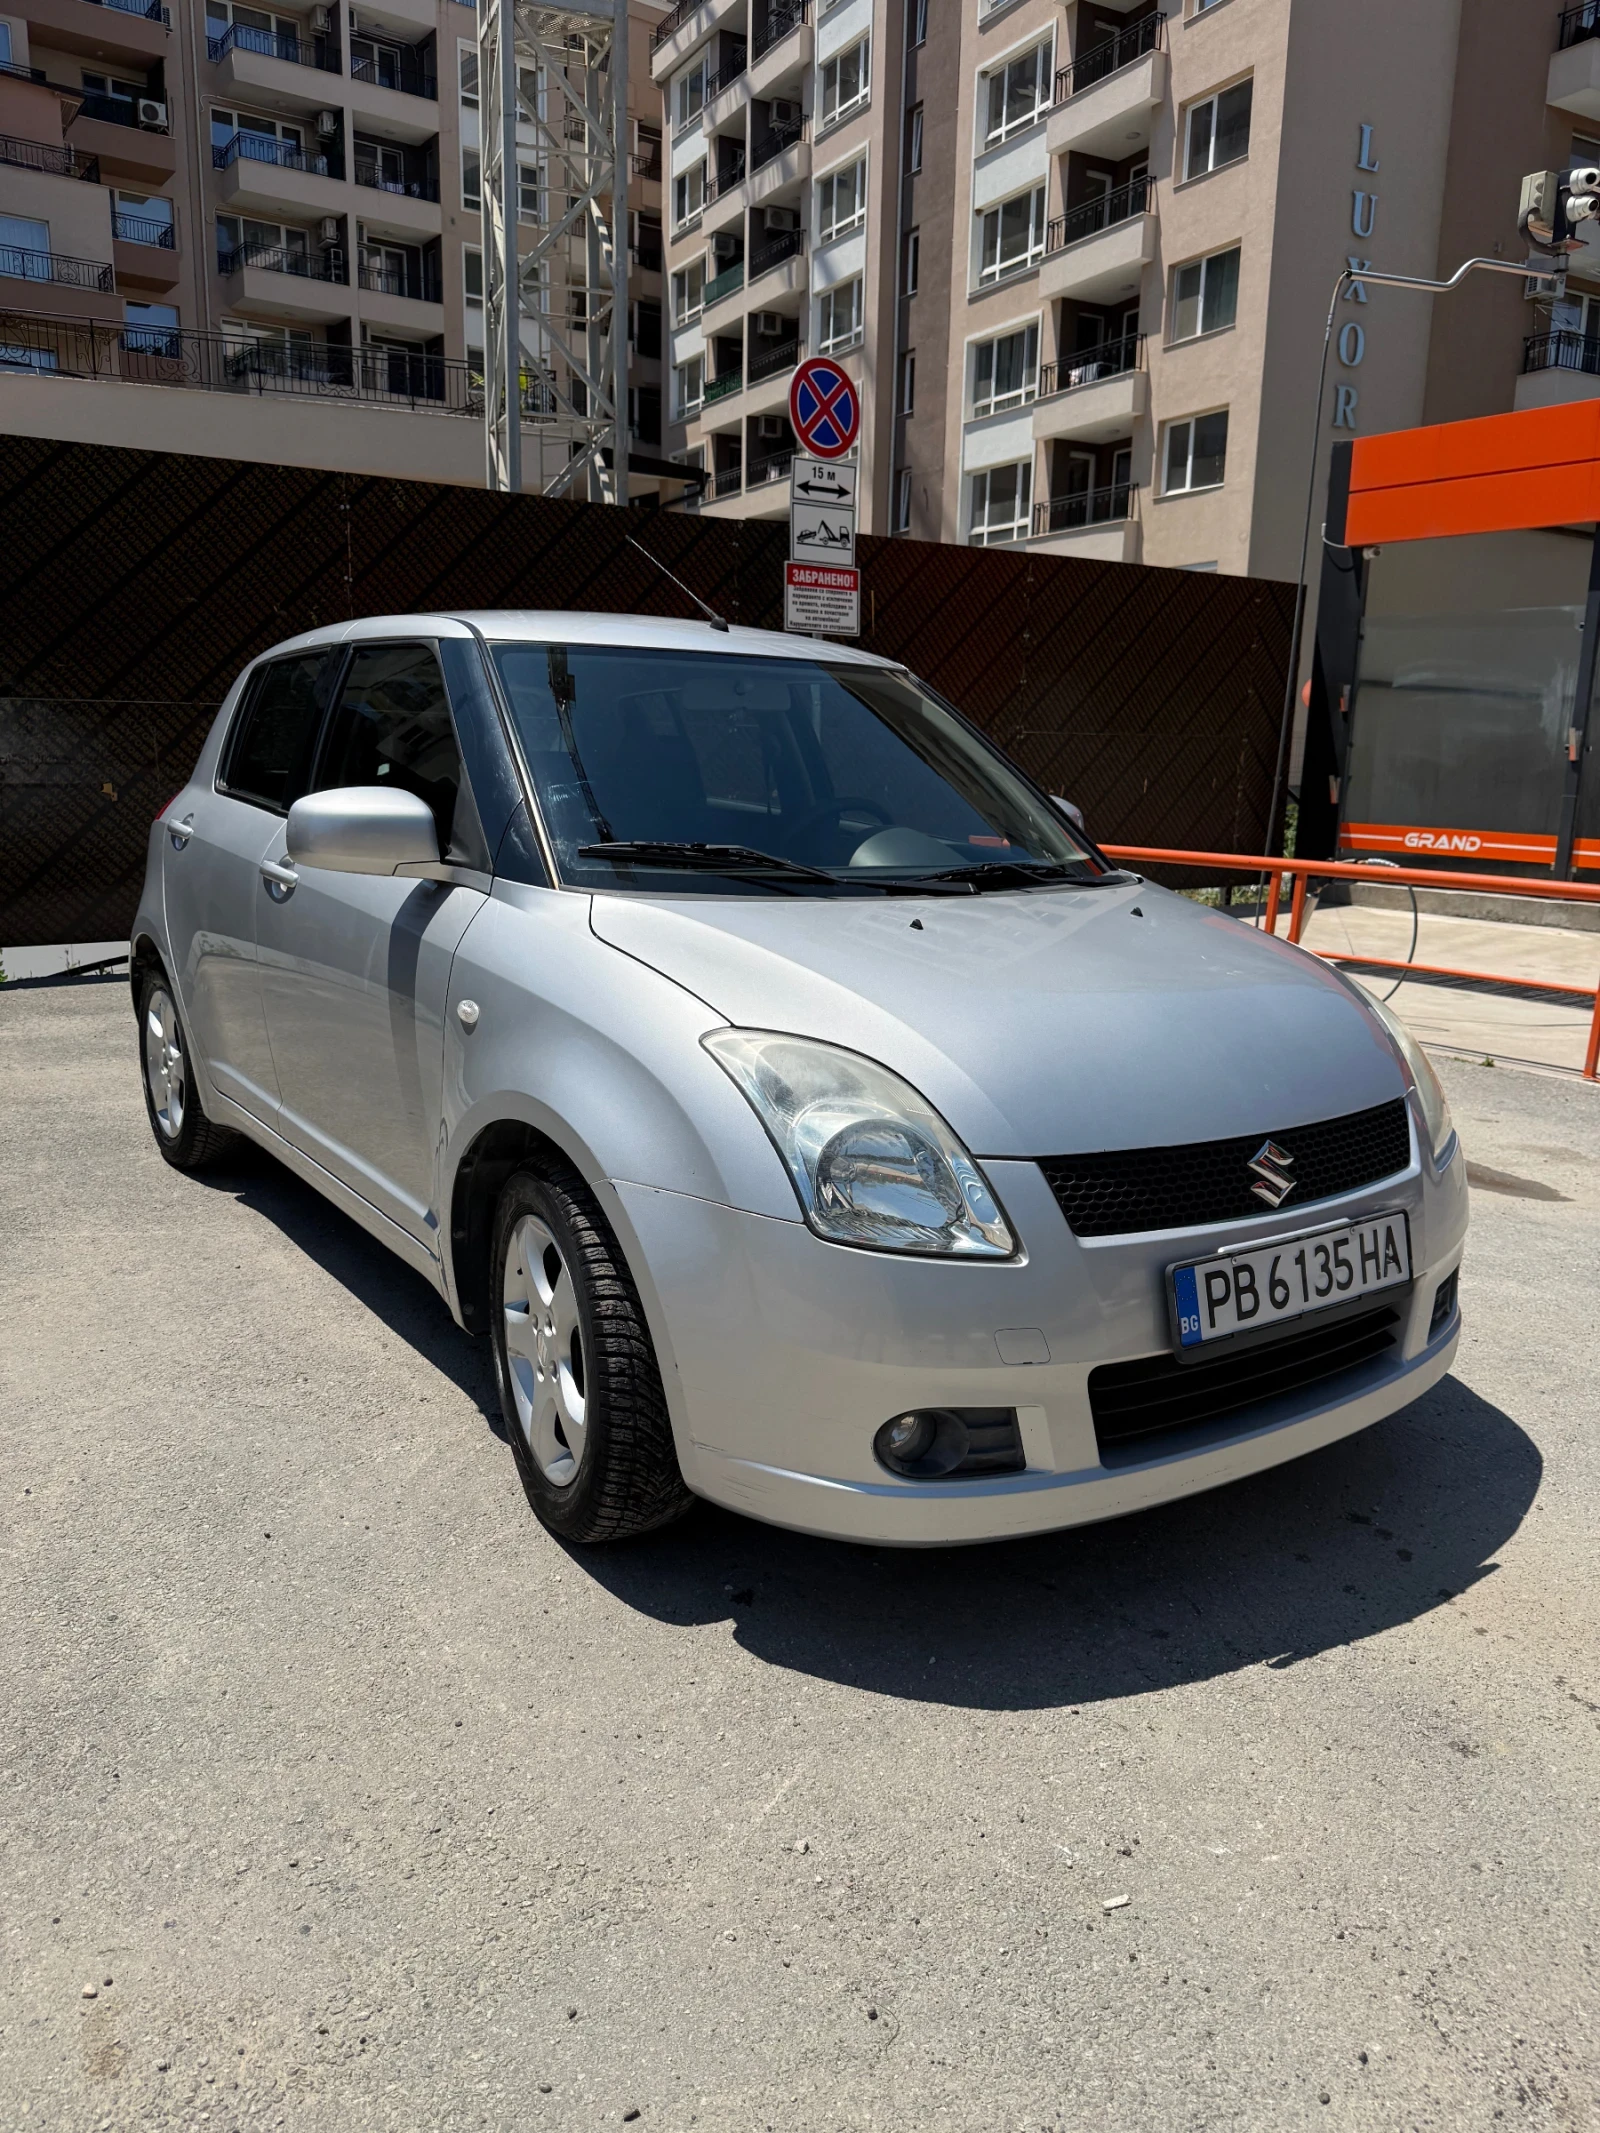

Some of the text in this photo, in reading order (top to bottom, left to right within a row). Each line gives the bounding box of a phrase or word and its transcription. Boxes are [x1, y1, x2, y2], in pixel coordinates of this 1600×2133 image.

[1333, 123, 1380, 429] LUXOR
[811, 465, 824, 480] 15
[792, 568, 854, 588] ЗАБРАНЕНО!
[1404, 832, 1481, 852] GRAND
[1180, 1314, 1199, 1335] BG
